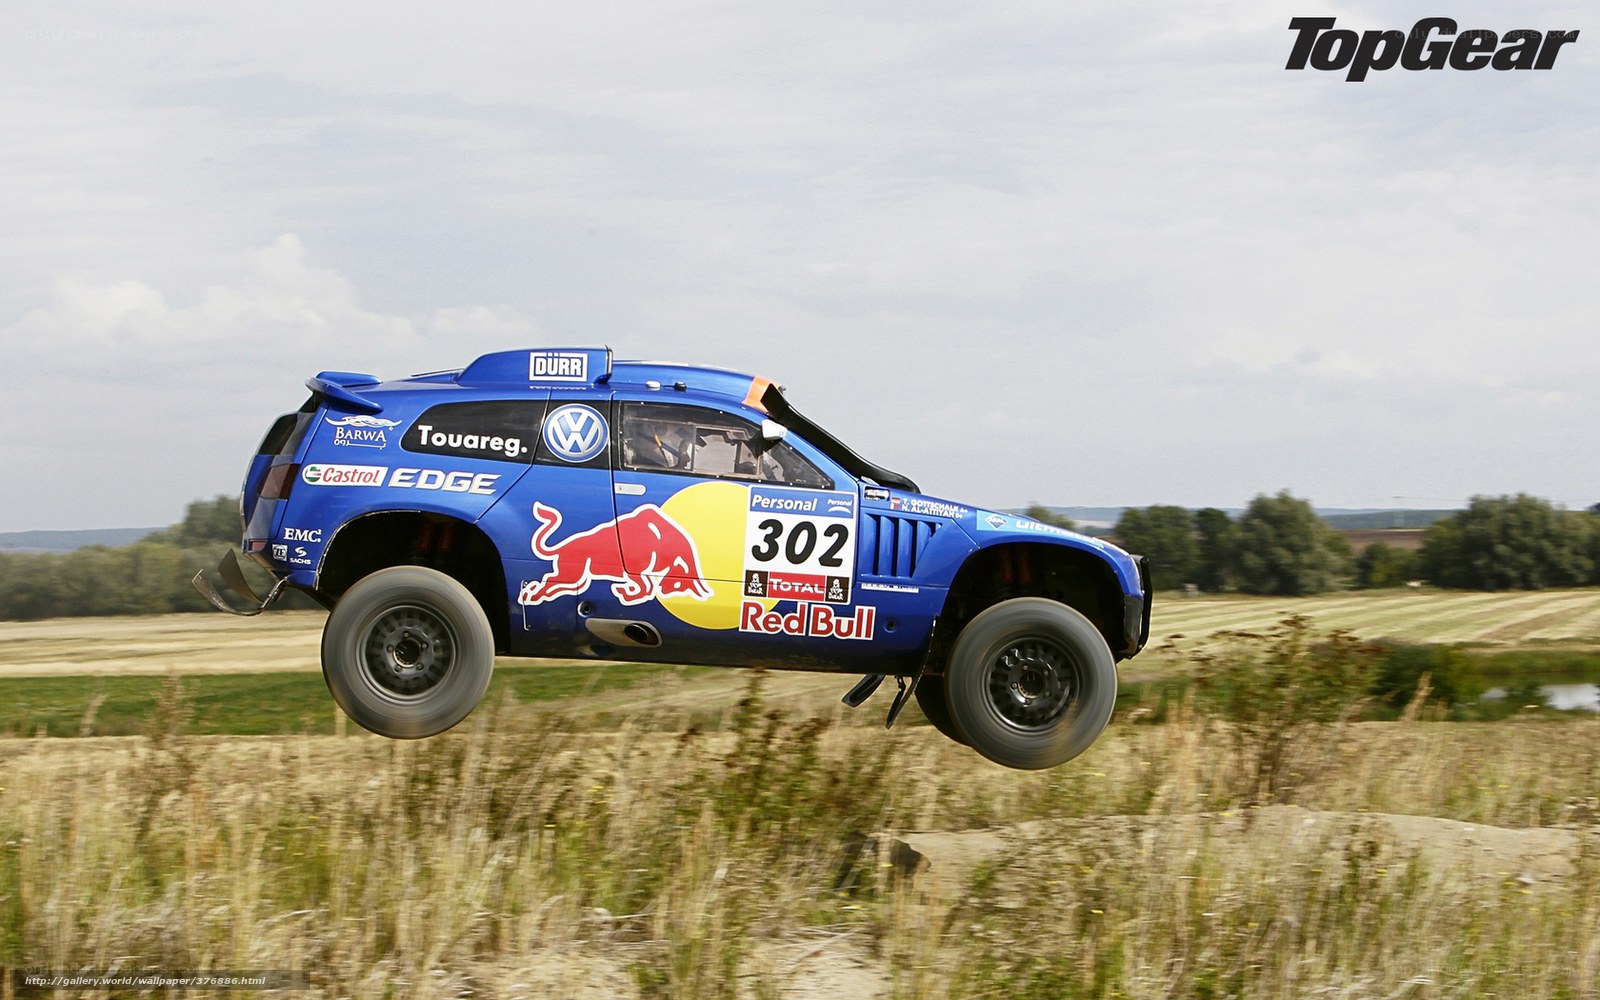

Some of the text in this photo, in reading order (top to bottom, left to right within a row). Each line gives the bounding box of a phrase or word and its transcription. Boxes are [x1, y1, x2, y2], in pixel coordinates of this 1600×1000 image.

[534, 352, 582, 376] DÜRR
[335, 427, 387, 442] BARWA
[417, 425, 528, 457] Touareg.
[322, 467, 501, 494] Castrol EDGE
[751, 494, 817, 512] Personal
[827, 499, 853, 507] Personal
[911, 499, 959, 513] GOTTSCHALK
[911, 506, 955, 519] AL-ATTIYAH
[751, 519, 849, 568] 302
[289, 557, 312, 565] SACHS
[769, 578, 824, 594] TOTAL
[741, 601, 876, 640] Red Bull
